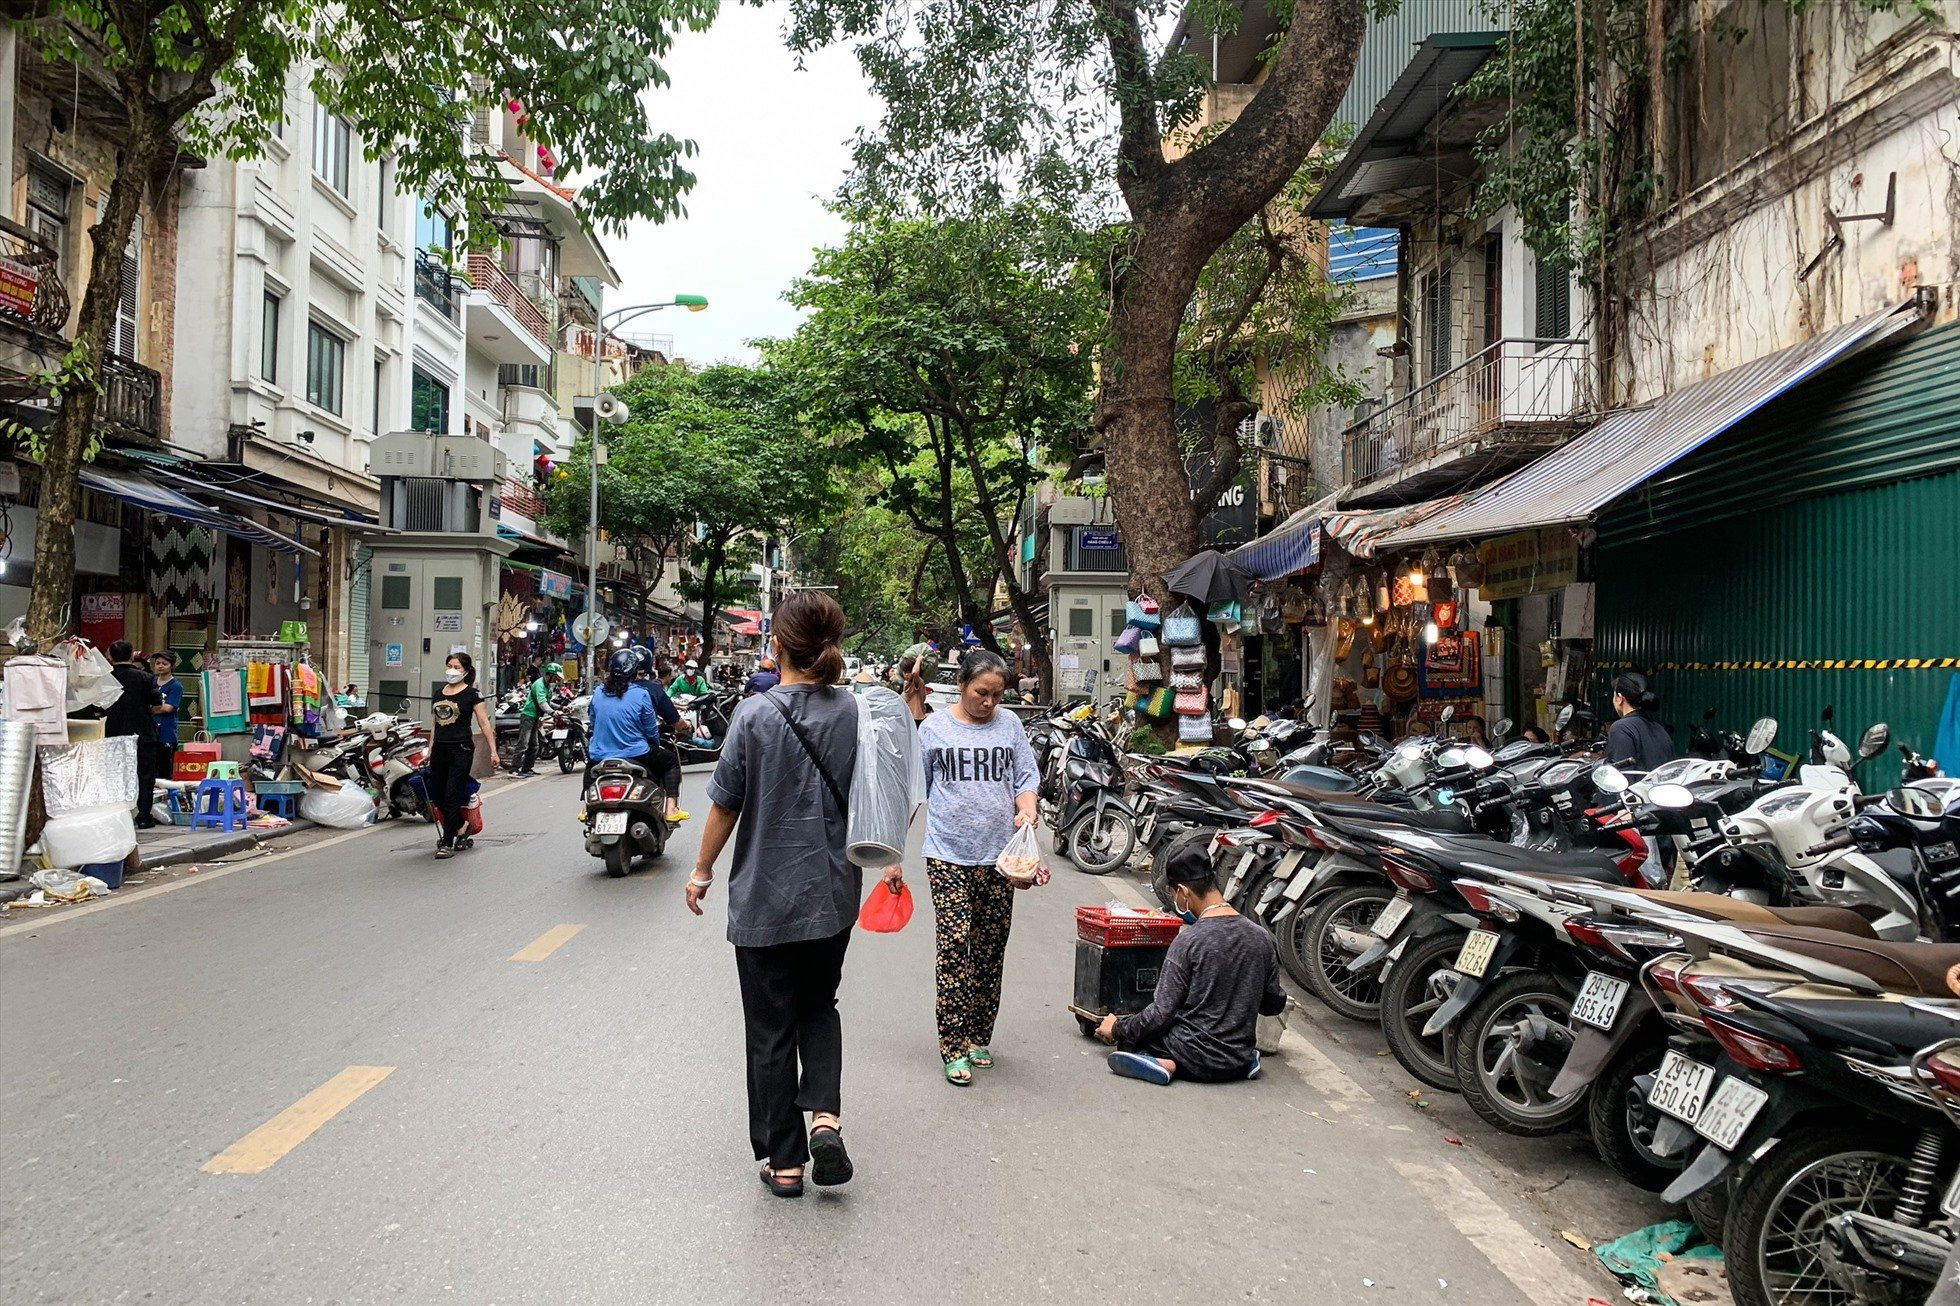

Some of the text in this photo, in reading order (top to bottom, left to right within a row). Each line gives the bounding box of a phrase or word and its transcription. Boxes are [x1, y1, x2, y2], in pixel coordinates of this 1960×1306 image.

[1467, 932, 1494, 954] 29-F1
[1458, 951, 1487, 974] 452.64
[1586, 975, 1620, 1002] 29-C1
[1574, 996, 1615, 1025] 965.49
[1665, 1056, 1705, 1091] 29-C1
[1652, 1079, 1700, 1119] 650.46
[1699, 1105, 1744, 1145] 016.46
